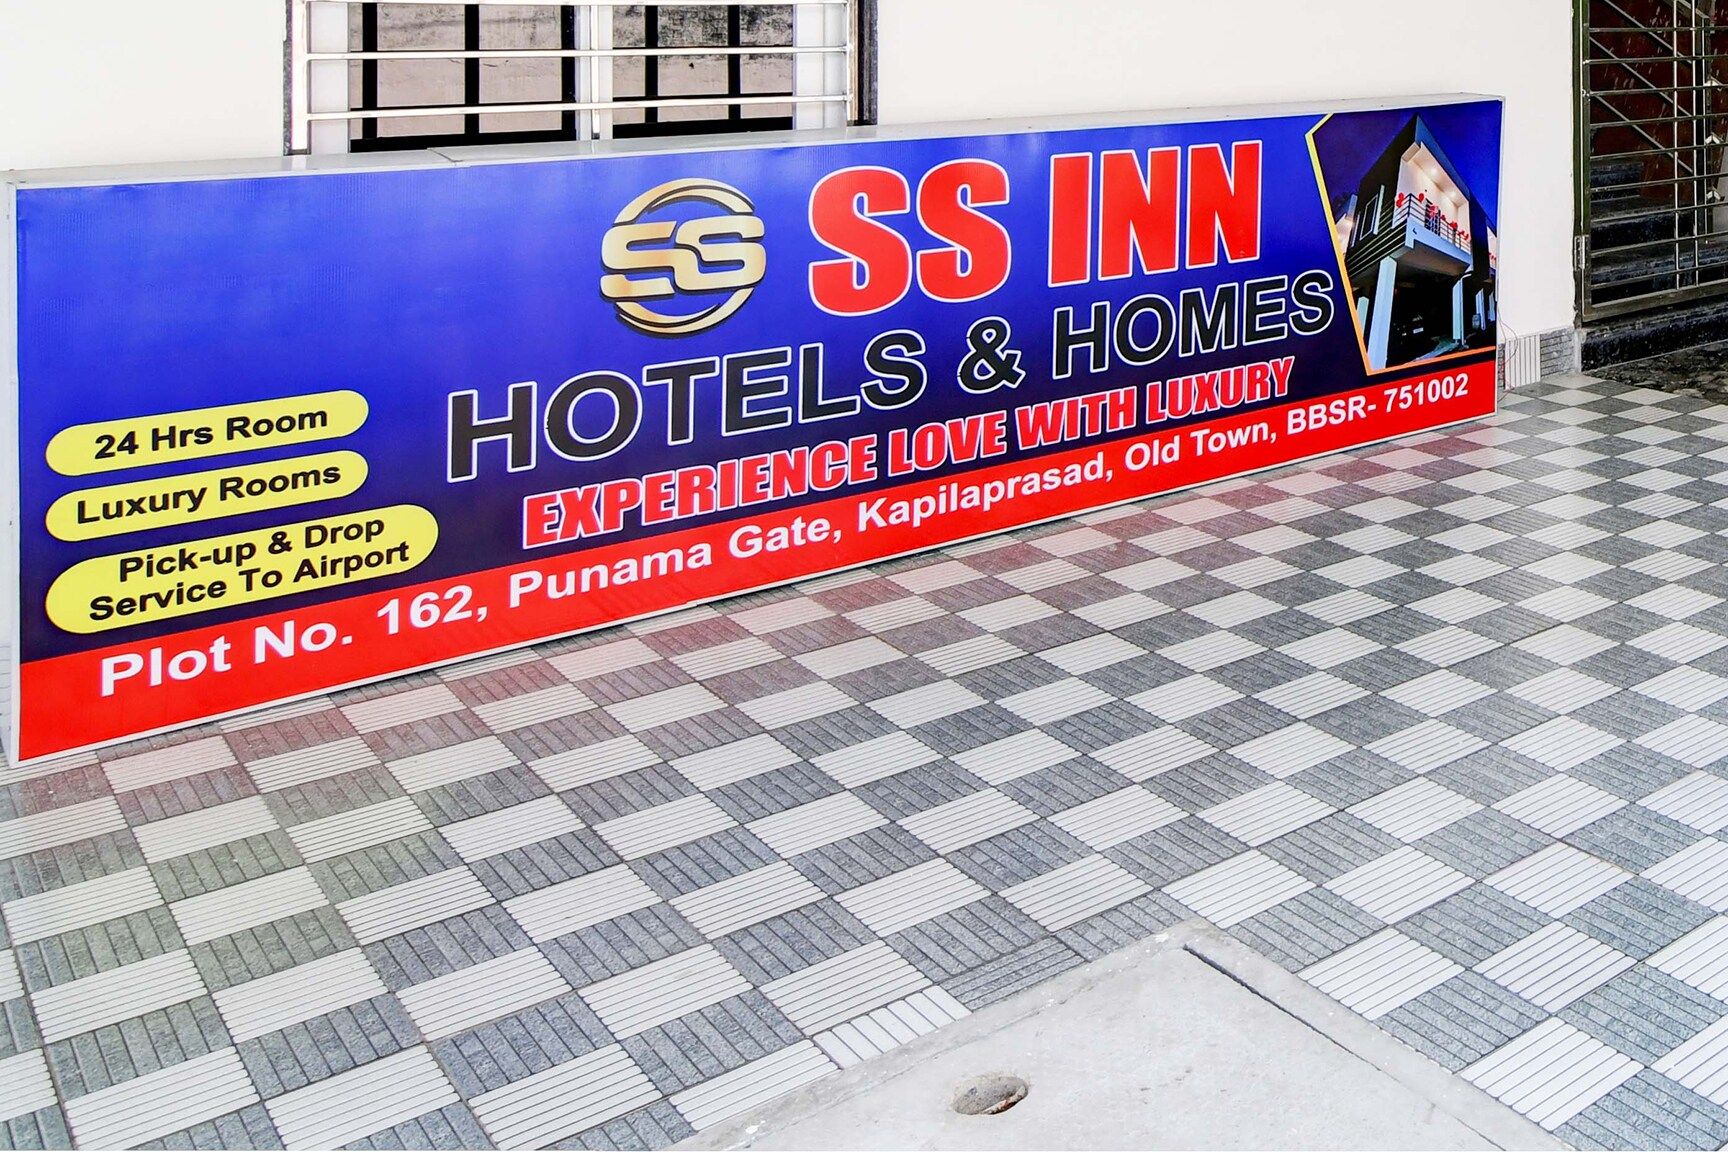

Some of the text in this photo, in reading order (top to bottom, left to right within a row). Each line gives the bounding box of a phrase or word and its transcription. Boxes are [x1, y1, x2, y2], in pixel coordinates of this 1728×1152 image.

[808, 140, 1262, 317] SS INN
[94, 407, 328, 460] 24 Hrs Room
[447, 269, 1334, 483] HOTELS & HOMES
[77, 462, 342, 524] Luxury Rooms
[523, 356, 1296, 549] EXPERIENCE LOVE WITH LUXURY
[89, 540, 410, 621] Service To Airport
[100, 372, 1469, 697] Plot No. 162, Punama Gate, Kapilaprasad, Old Town, BBSR- 751002
[119, 516, 385, 583] Pick-up & Drop
